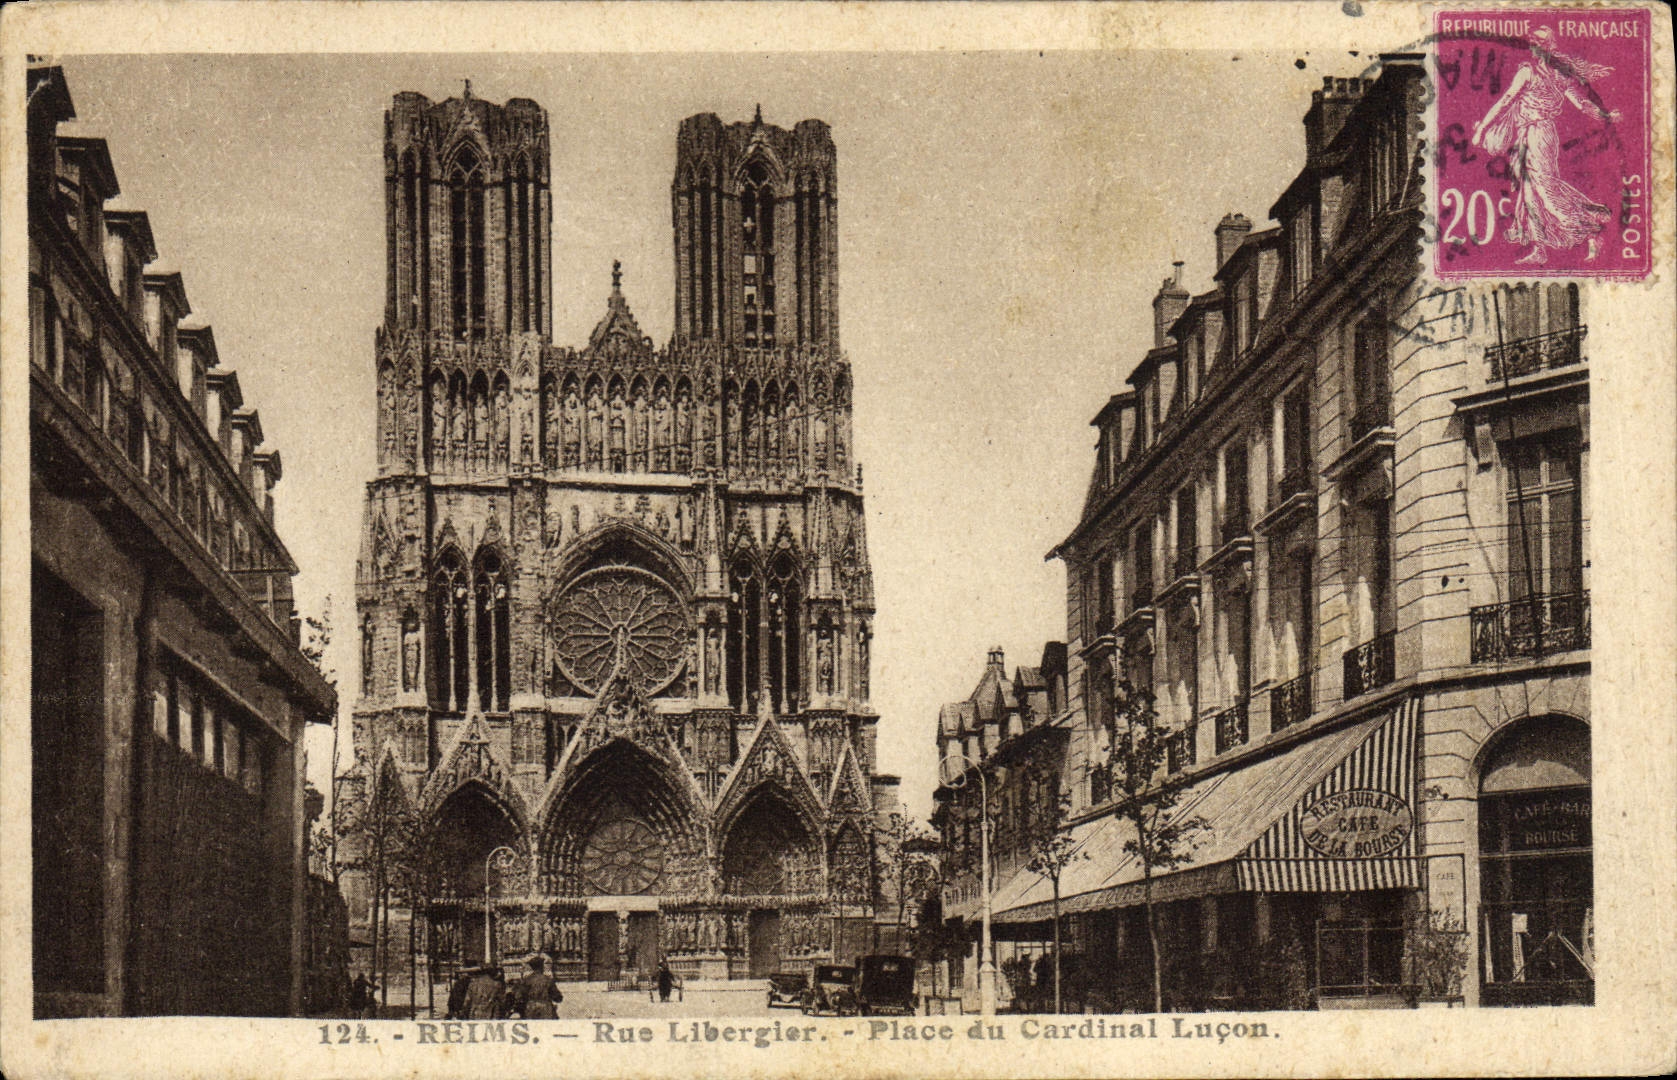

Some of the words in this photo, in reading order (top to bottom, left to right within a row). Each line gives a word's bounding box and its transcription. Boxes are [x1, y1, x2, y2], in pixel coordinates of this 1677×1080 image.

[1558, 20, 1639, 40] FRANÇAISE
[1622, 173, 1641, 259] POSTES
[1311, 792, 1404, 820] RESTAURANT
[1354, 823, 1408, 858] BOURSE
